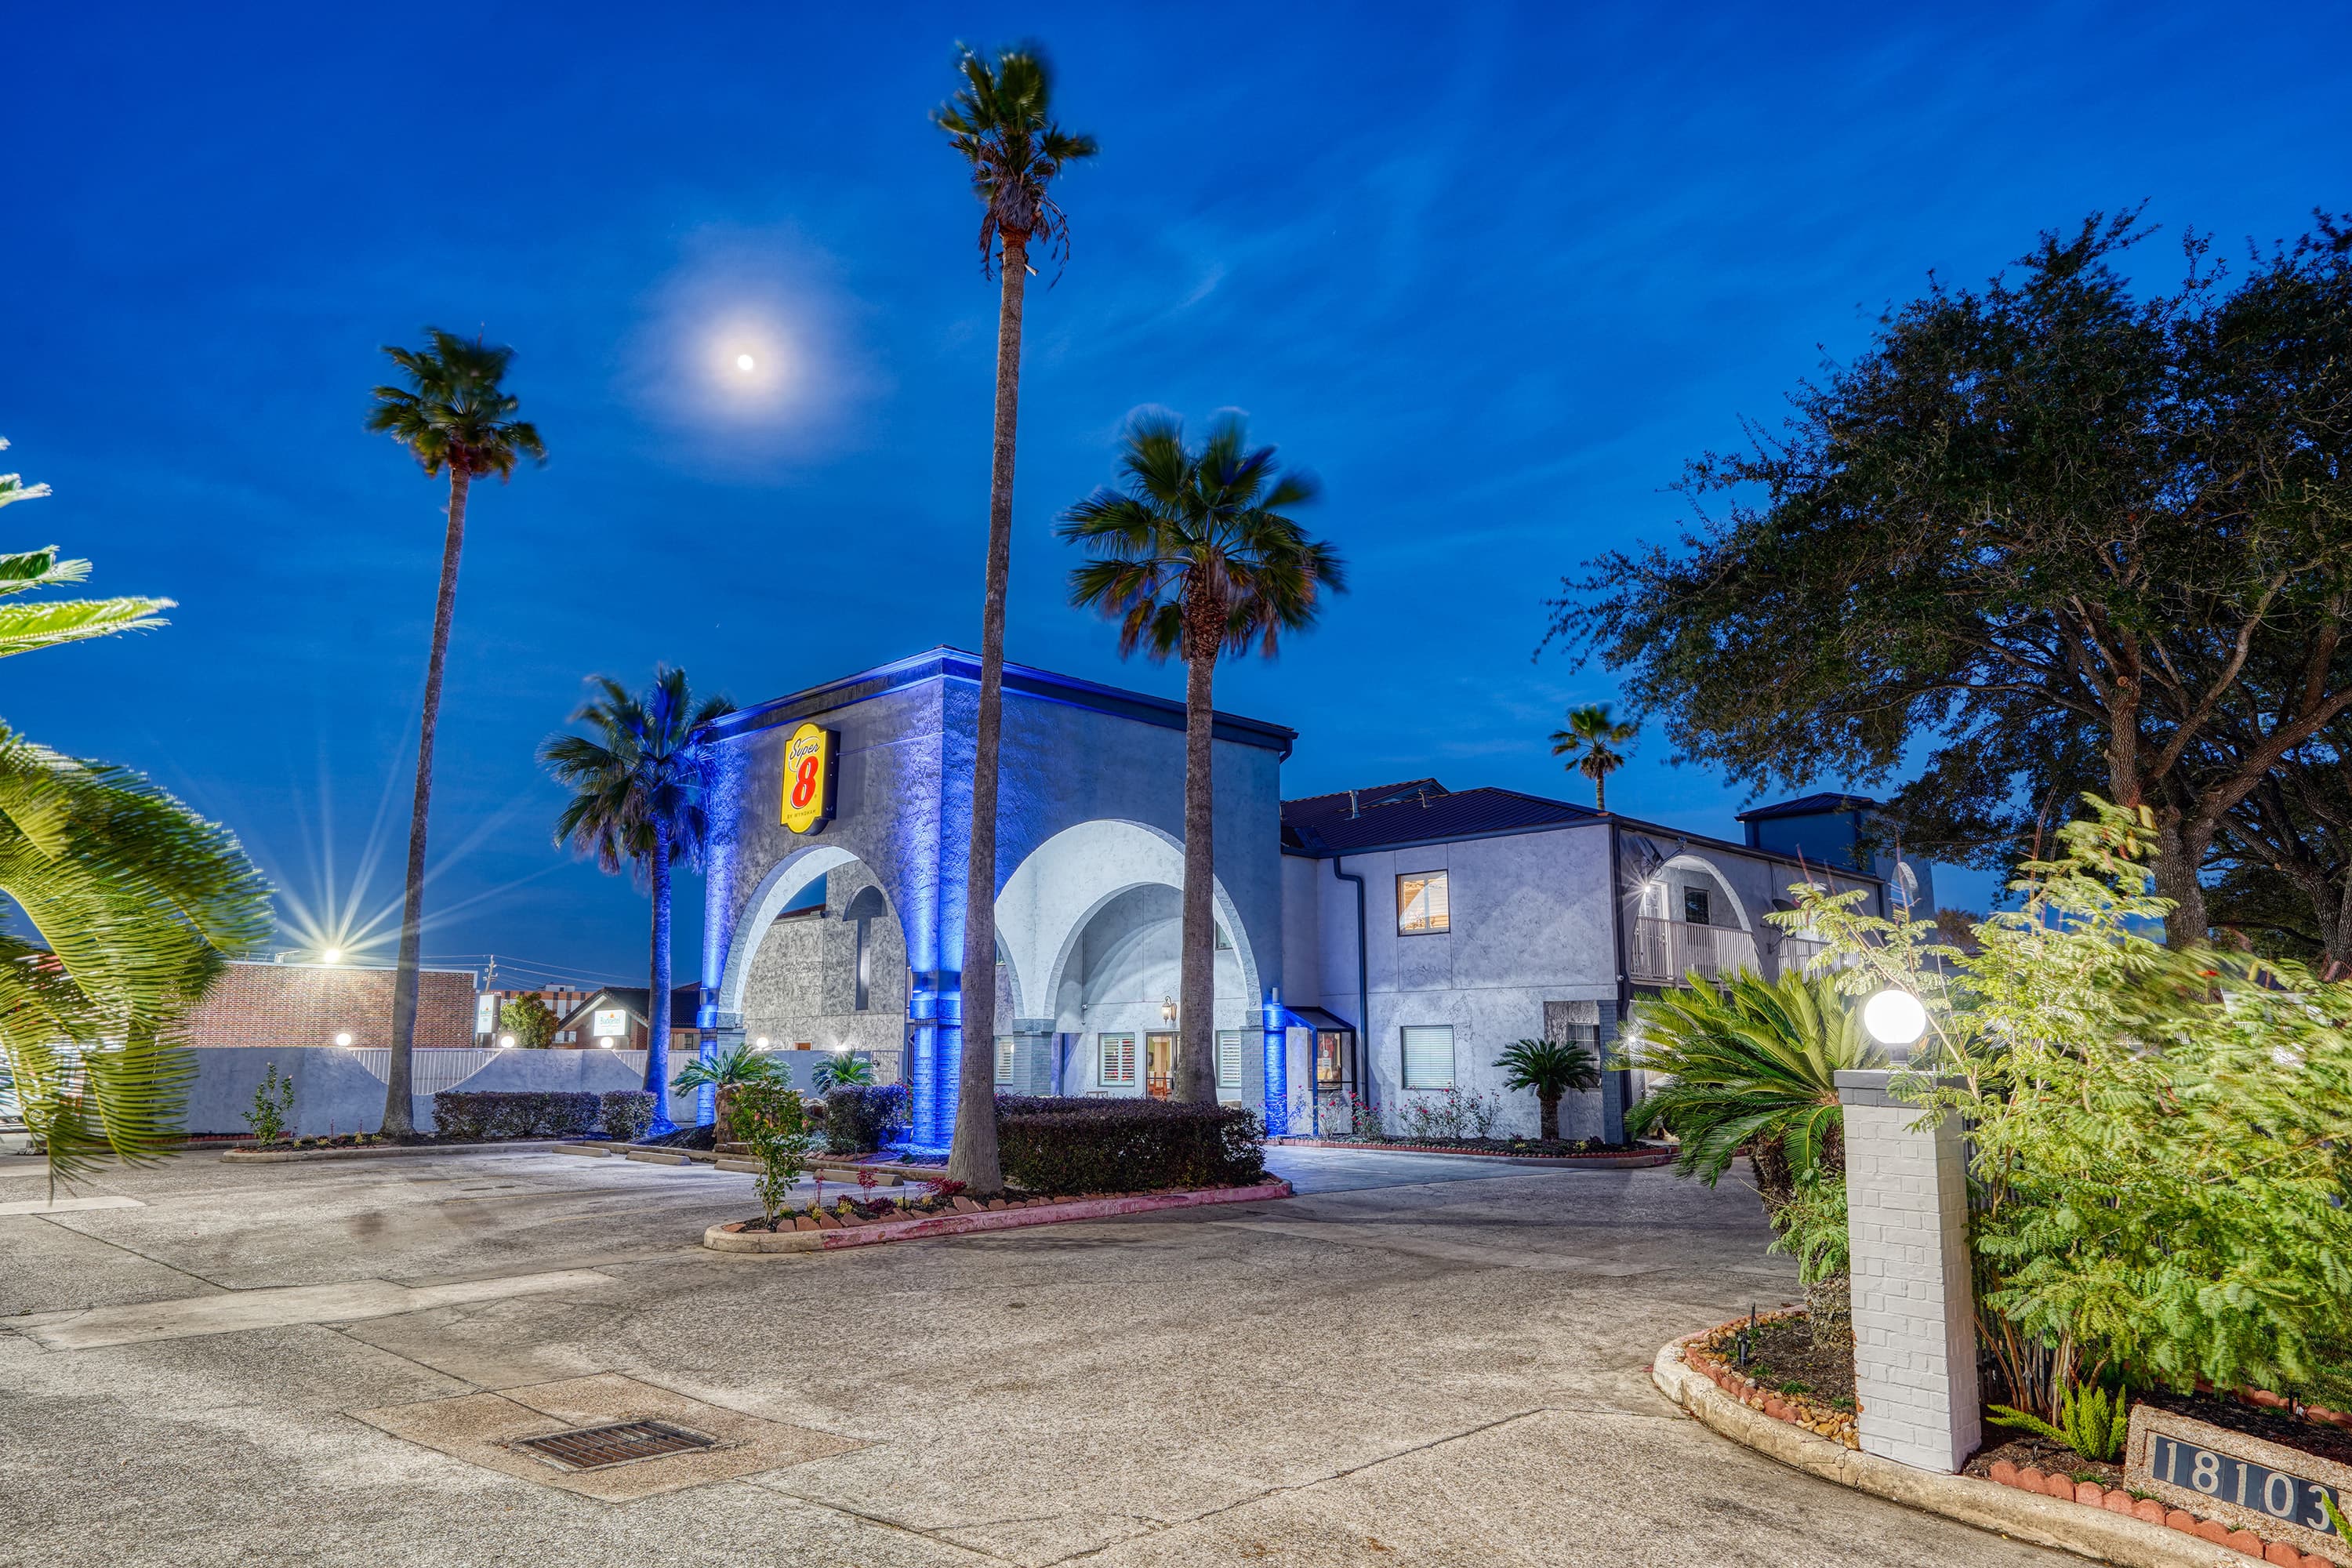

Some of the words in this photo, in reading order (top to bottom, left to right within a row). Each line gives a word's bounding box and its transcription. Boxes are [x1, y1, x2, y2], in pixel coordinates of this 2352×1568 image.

[789, 739, 820, 768] Super
[790, 757, 818, 809] 8
[2165, 1441, 2331, 1531] 18103
